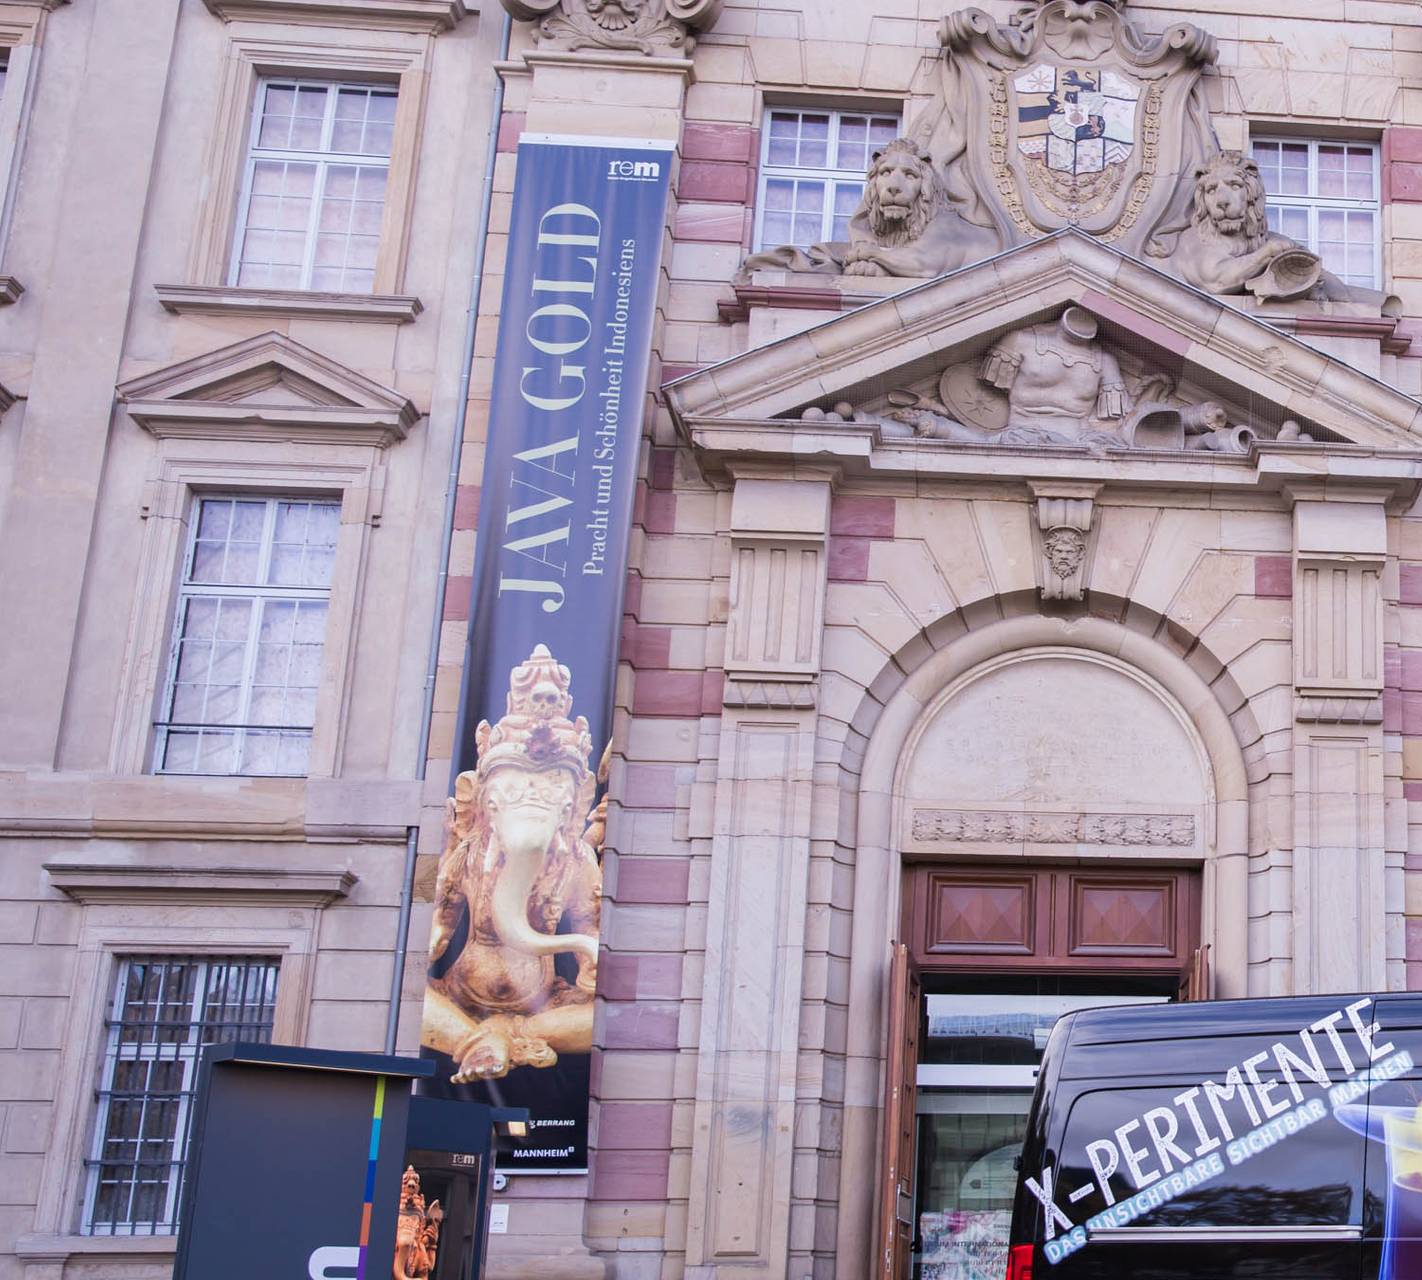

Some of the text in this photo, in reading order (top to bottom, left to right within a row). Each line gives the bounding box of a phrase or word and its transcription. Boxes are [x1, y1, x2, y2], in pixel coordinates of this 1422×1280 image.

[608, 161, 659, 177] rem
[498, 202, 602, 613] JAVA GOLD
[582, 239, 635, 576] Pracht und Schönheit Indonesiens
[452, 1153, 475, 1165] rem
[513, 1148, 569, 1158] MANNHEIM
[536, 1119, 576, 1127] BERRANG
[1024, 997, 1395, 1241] X-PERIMENTE
[1046, 1051, 1414, 1264] DAS UNSICHTBARE SICHTBAR MACHEN
